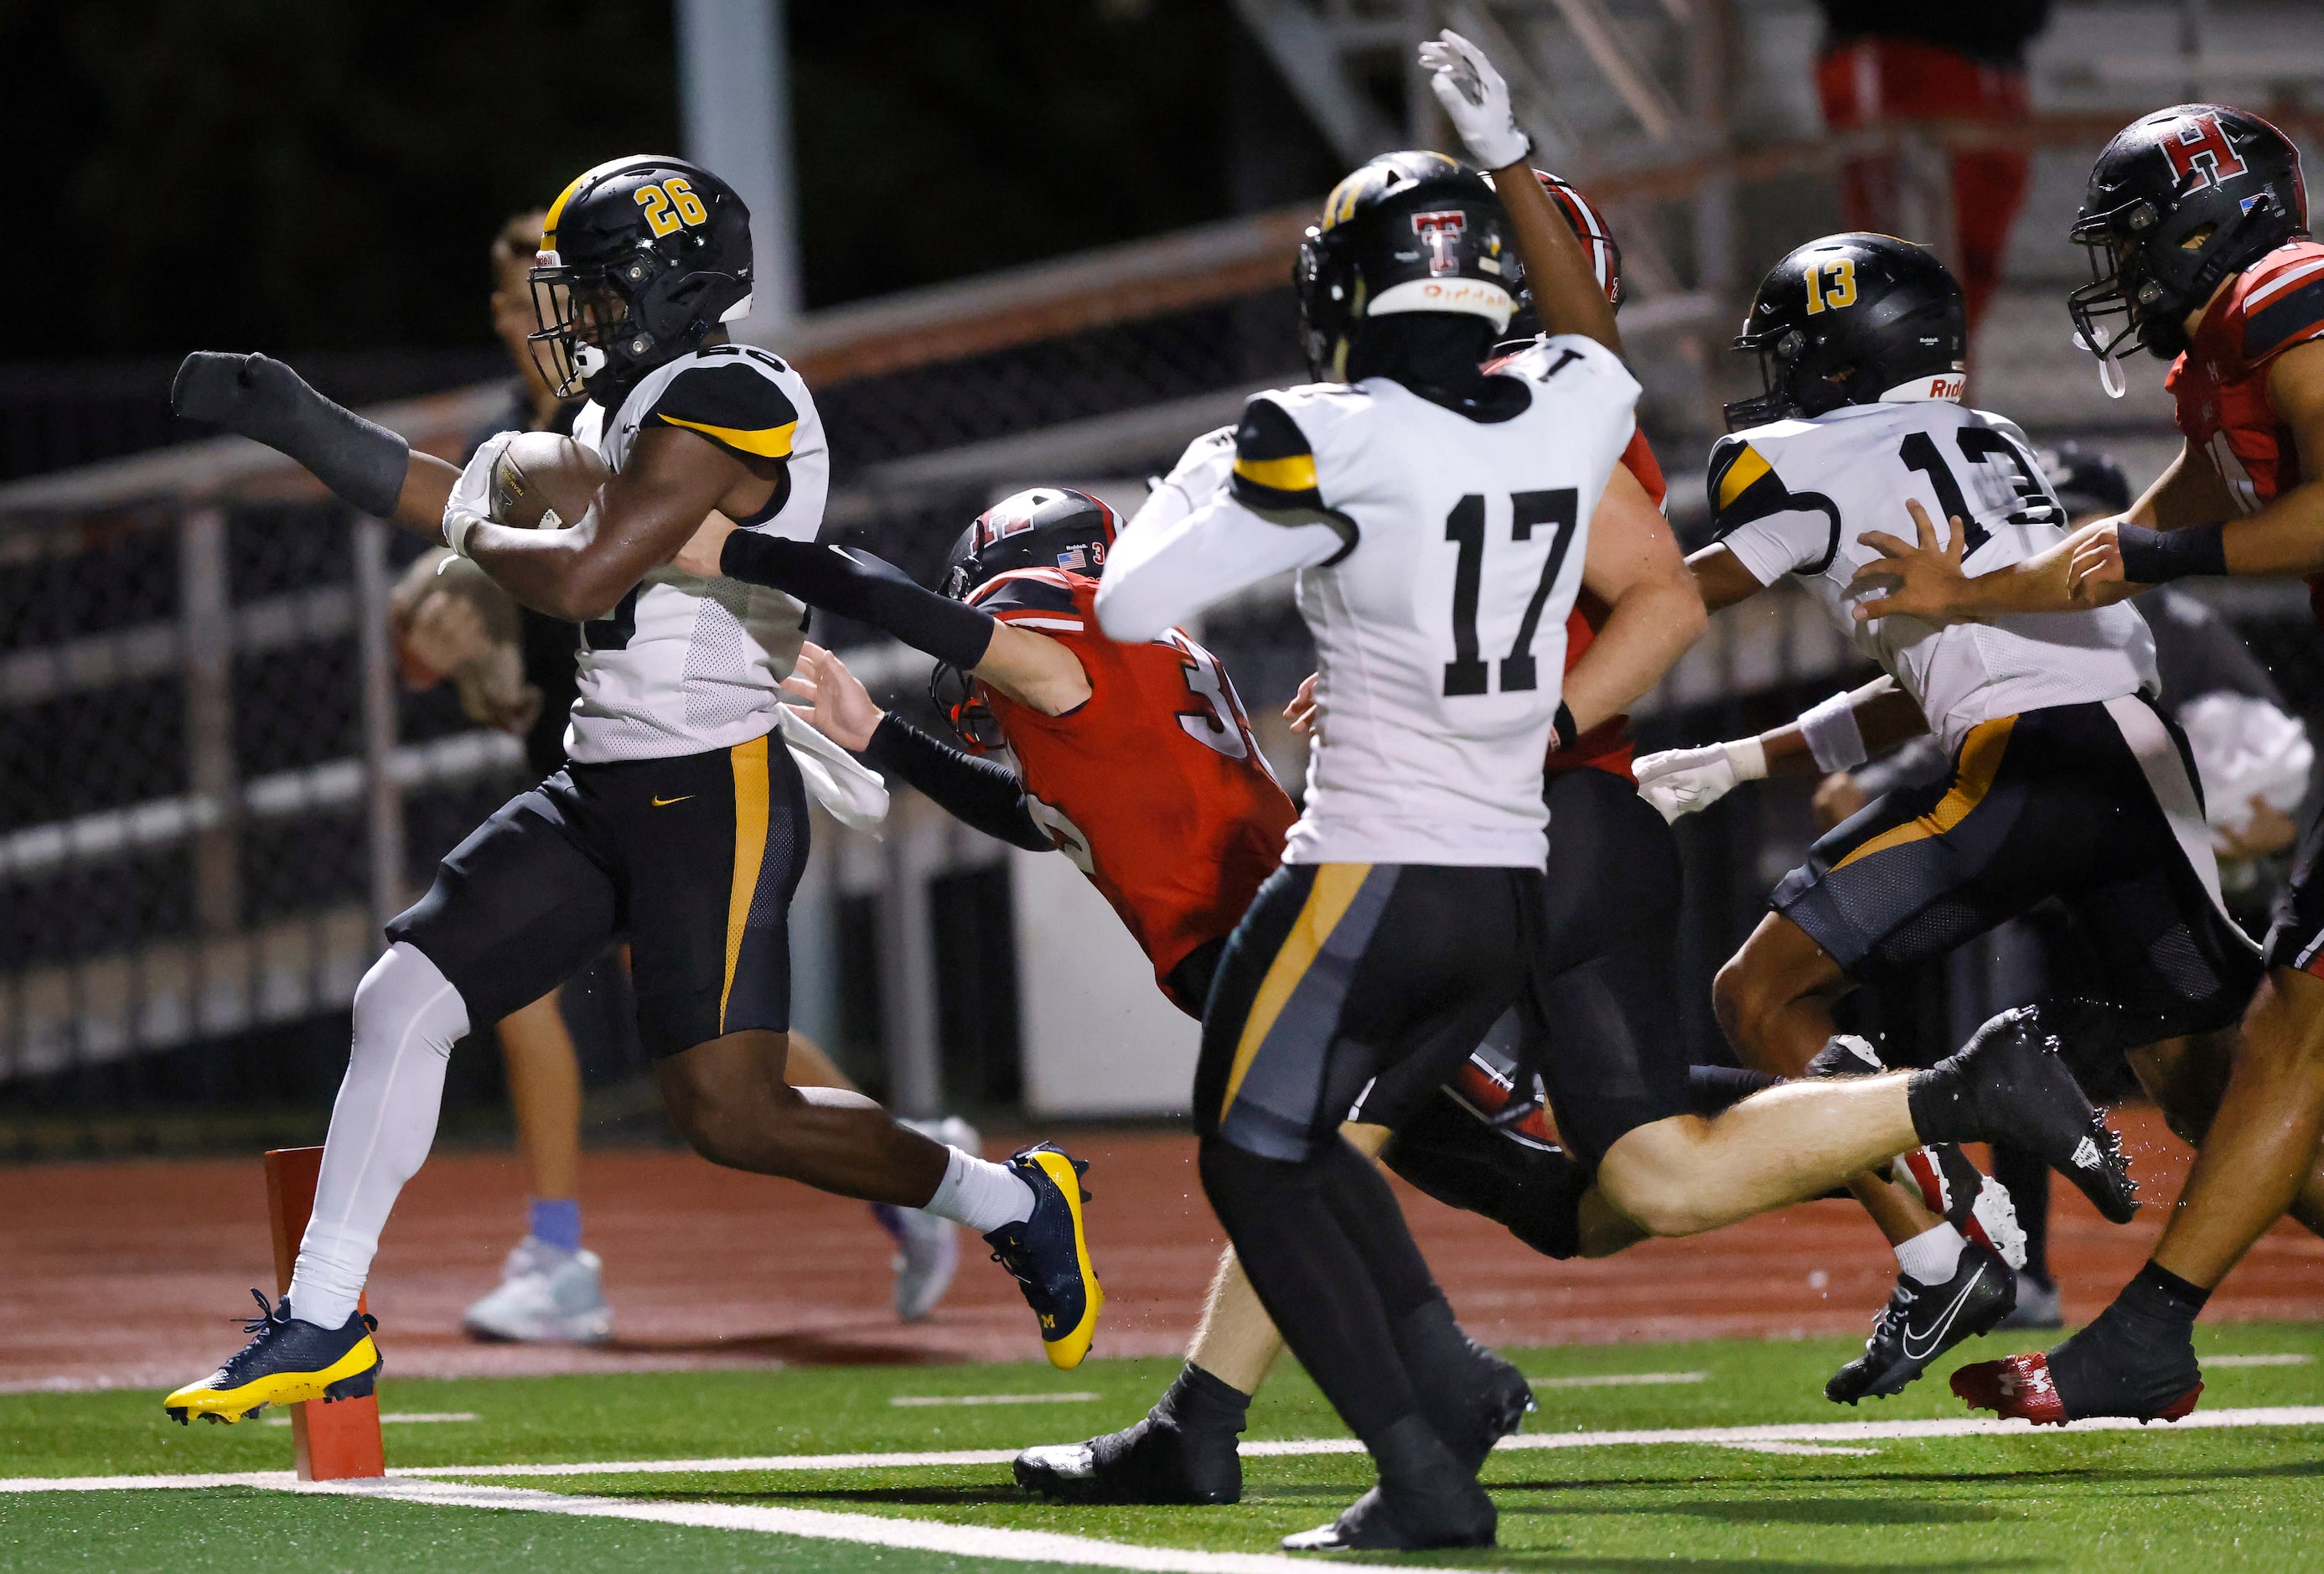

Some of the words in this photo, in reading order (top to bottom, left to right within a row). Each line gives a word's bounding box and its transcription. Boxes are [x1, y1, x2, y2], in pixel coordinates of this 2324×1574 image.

[633, 178, 707, 238] 26
[1804, 258, 1857, 315] 13
[1898, 427, 2066, 564] 13
[1443, 486, 1578, 696] 17
[1041, 1313, 1056, 1328] M
